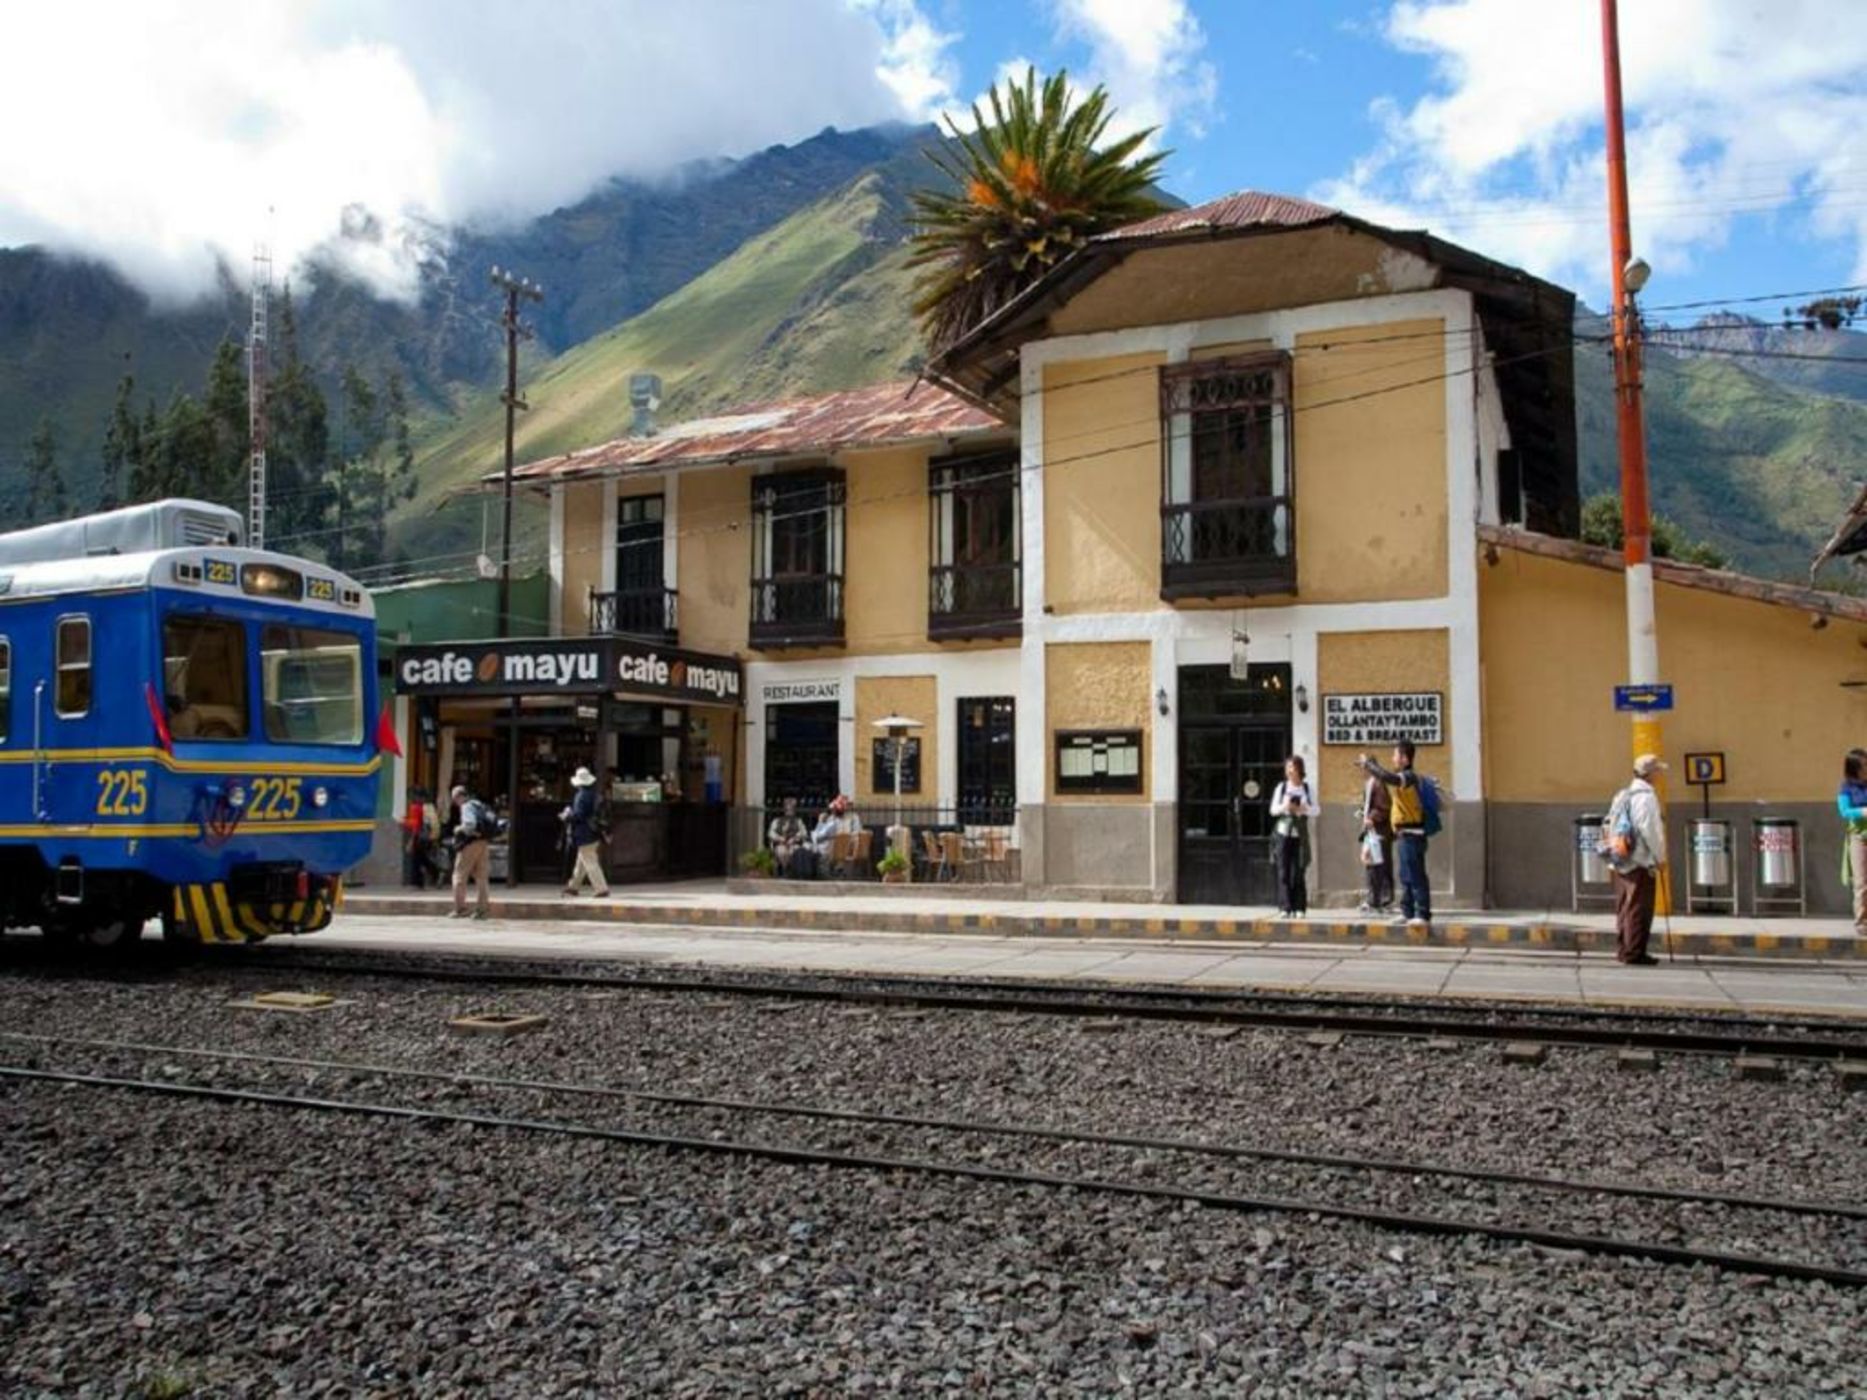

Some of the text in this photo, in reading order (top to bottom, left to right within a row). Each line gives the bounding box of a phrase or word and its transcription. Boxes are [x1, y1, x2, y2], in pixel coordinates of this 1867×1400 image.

[207, 562, 234, 583] 225
[310, 580, 333, 599] 225
[402, 653, 598, 685] cafe mayu
[619, 653, 739, 697] cafe mayu
[763, 683, 840, 699] RESTAURANT
[1327, 697, 1438, 712] EL ALBERGUE
[1328, 714, 1438, 727] OLLANTAYTAMBO
[1695, 757, 1713, 780] D
[97, 770, 147, 815] 225
[247, 778, 303, 819] 225
